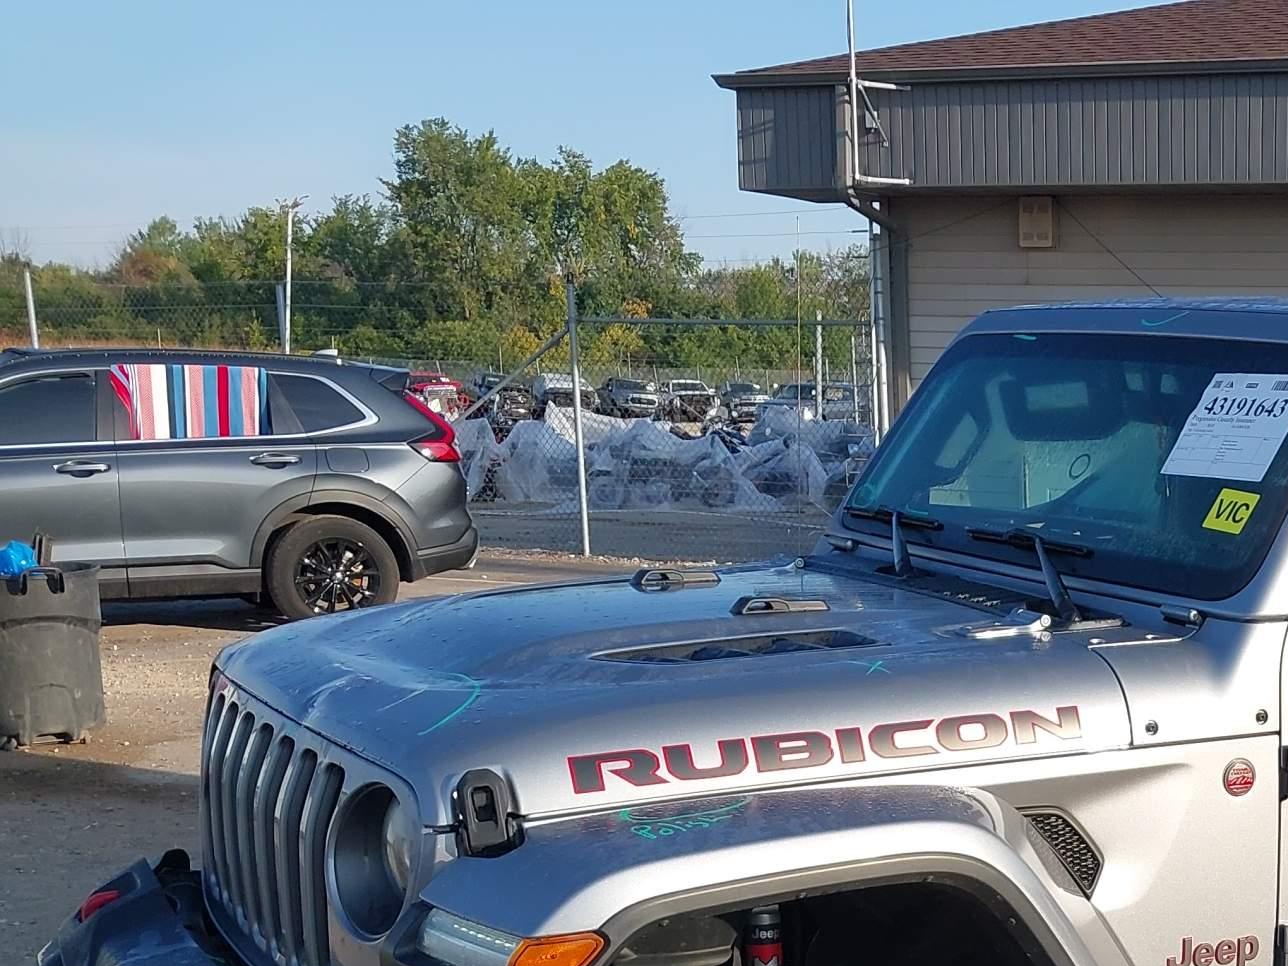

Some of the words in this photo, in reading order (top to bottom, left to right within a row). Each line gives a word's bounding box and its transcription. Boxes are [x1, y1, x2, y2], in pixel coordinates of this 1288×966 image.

[1204, 396, 1288, 418] 43191643
[1215, 498, 1250, 523] VIC
[567, 704, 1082, 794] RUBICON
[751, 928, 780, 940] Jeep
